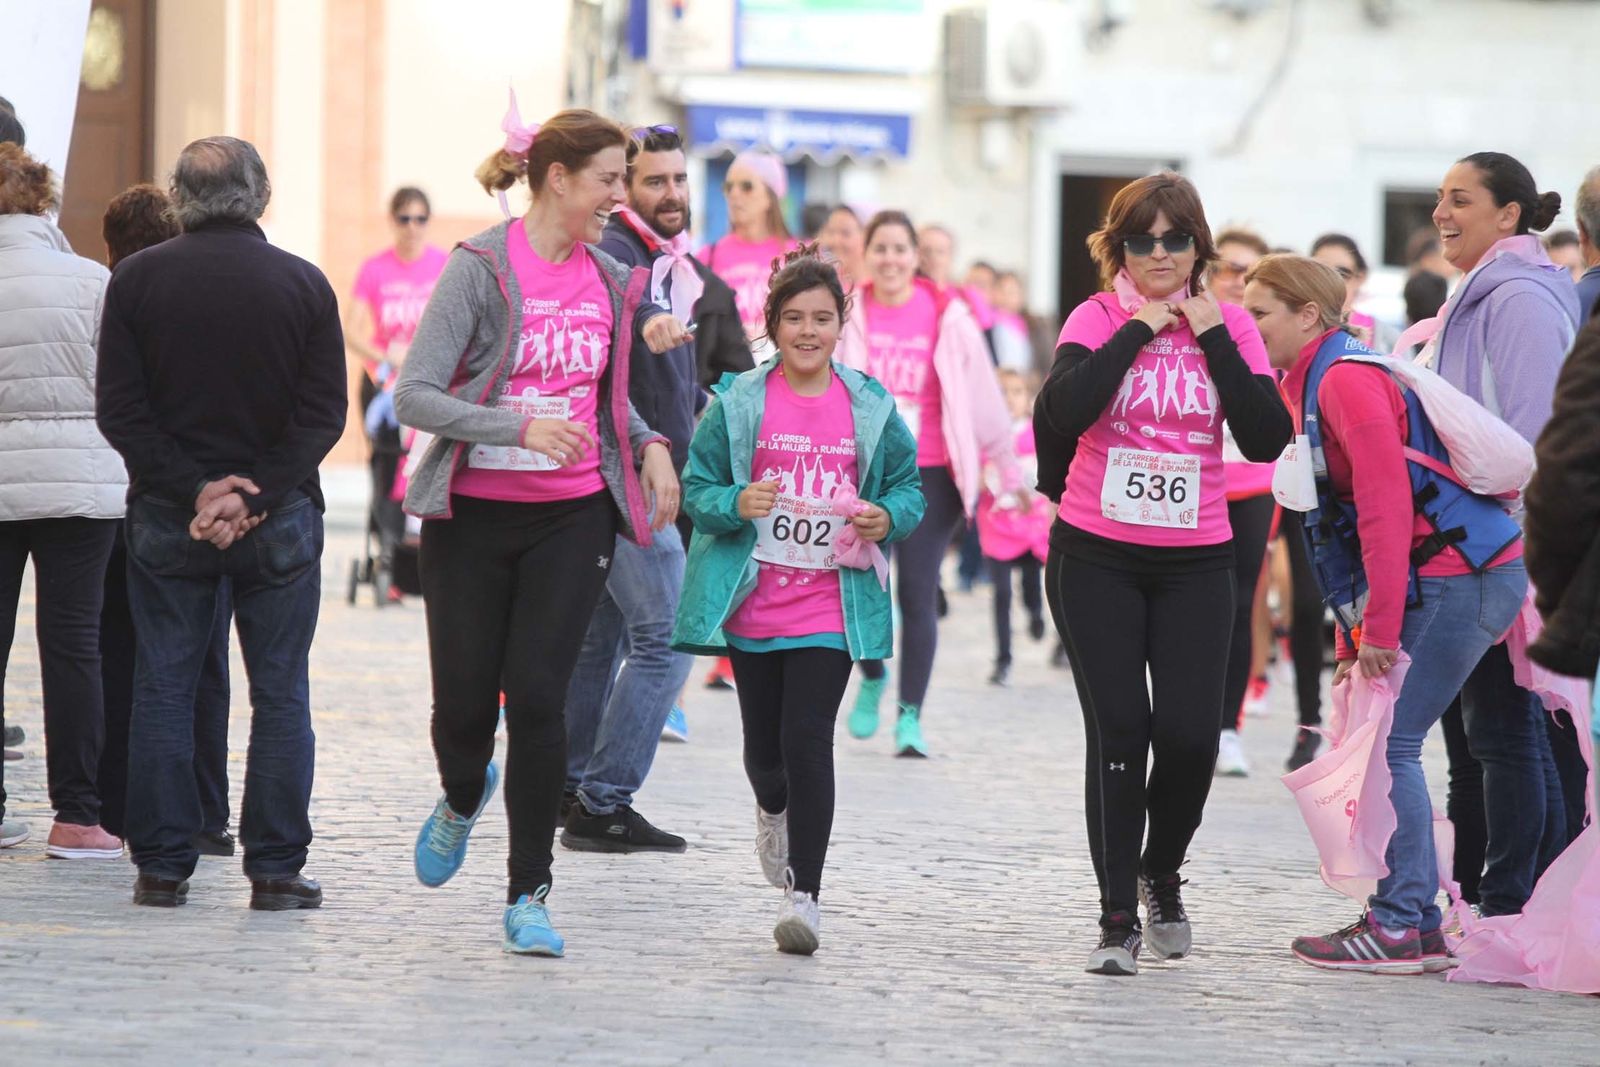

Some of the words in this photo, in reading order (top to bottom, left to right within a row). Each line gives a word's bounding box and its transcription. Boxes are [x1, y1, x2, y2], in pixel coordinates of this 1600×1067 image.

[524, 298, 561, 308] CARRERA
[532, 307, 559, 316] MUJER
[564, 309, 600, 319] RUNNING
[1142, 345, 1173, 355] MUJER
[530, 408, 565, 416] RUNNING
[771, 433, 812, 445] CARRERA
[840, 437, 856, 447] PIN
[756, 440, 767, 449] DE
[768, 441, 779, 451] LA
[780, 443, 811, 453] MUJER
[812, 446, 818, 454] &
[820, 445, 856, 456] RUNNING
[1126, 453, 1160, 463] CARRERA
[1112, 458, 1123, 467] DE
[1123, 459, 1132, 467] LA
[1133, 460, 1159, 471] MUJER
[1166, 465, 1198, 474] RUNNING
[1125, 471, 1187, 504] 536
[780, 503, 805, 515] MUJER
[772, 514, 831, 547] 602
